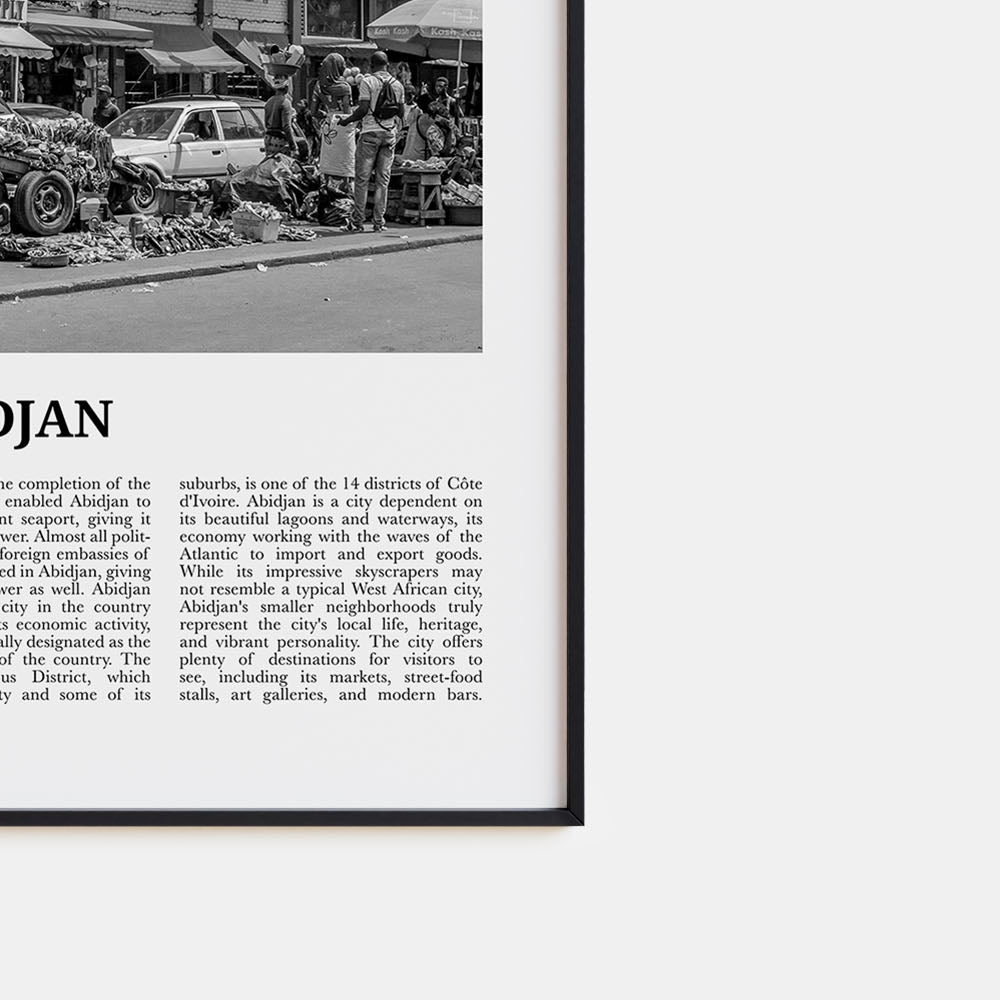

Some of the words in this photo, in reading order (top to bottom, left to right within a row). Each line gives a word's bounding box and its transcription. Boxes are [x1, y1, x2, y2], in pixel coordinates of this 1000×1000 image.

[18, 476, 101, 495] completion
[105, 476, 123, 490] of
[127, 476, 151, 491] the
[179, 476, 241, 493] suburbs,
[245, 476, 257, 490] is
[260, 480, 288, 491] one
[292, 476, 310, 490] of
[313, 476, 337, 491] the
[343, 476, 360, 490] 14
[363, 476, 422, 491] districts
[425, 476, 443, 490] of
[447, 476, 483, 491] Côte
[179, 511, 197, 526] its
[204, 511, 269, 526] beautiful
[277, 511, 334, 530] lagoons
[341, 511, 370, 526] and
[377, 514, 459, 530] waterways,
[466, 511, 483, 526] its
[0, 546, 51, 566] foreign
[56, 546, 129, 561] embassies
[133, 546, 151, 561] of
[179, 546, 239, 561] Atlantic
[250, 549, 265, 561] to
[275, 546, 327, 565] import
[337, 546, 366, 561] and
[376, 549, 425, 565] export
[435, 546, 483, 565] goods.
[29, 585, 45, 596] as
[50, 581, 85, 596] well.
[91, 581, 151, 600] Abidjan
[179, 584, 204, 596] not
[210, 581, 276, 596] resemble
[281, 585, 291, 596] a
[296, 581, 345, 600] typical
[351, 581, 387, 596] West
[392, 581, 448, 596] African
[453, 581, 483, 600] city,
[15, 616, 87, 631] economic
[94, 616, 151, 635] activity,
[22, 651, 46, 666] the
[53, 655, 113, 670] country.
[119, 651, 151, 666] The
[179, 651, 226, 670] plenty
[238, 651, 256, 666] of
[268, 651, 357, 666] destinations
[369, 651, 391, 666] for
[402, 651, 456, 666] visitors
[468, 655, 483, 666] to
[21, 687, 50, 701] and
[59, 691, 98, 701] some
[107, 686, 125, 701] of
[134, 687, 152, 701] its
[179, 687, 220, 704] stalls,
[230, 690, 252, 701] art
[262, 687, 328, 705] galleries,
[338, 687, 367, 701] and
[377, 687, 436, 701] modern
[447, 687, 483, 701] bars.
